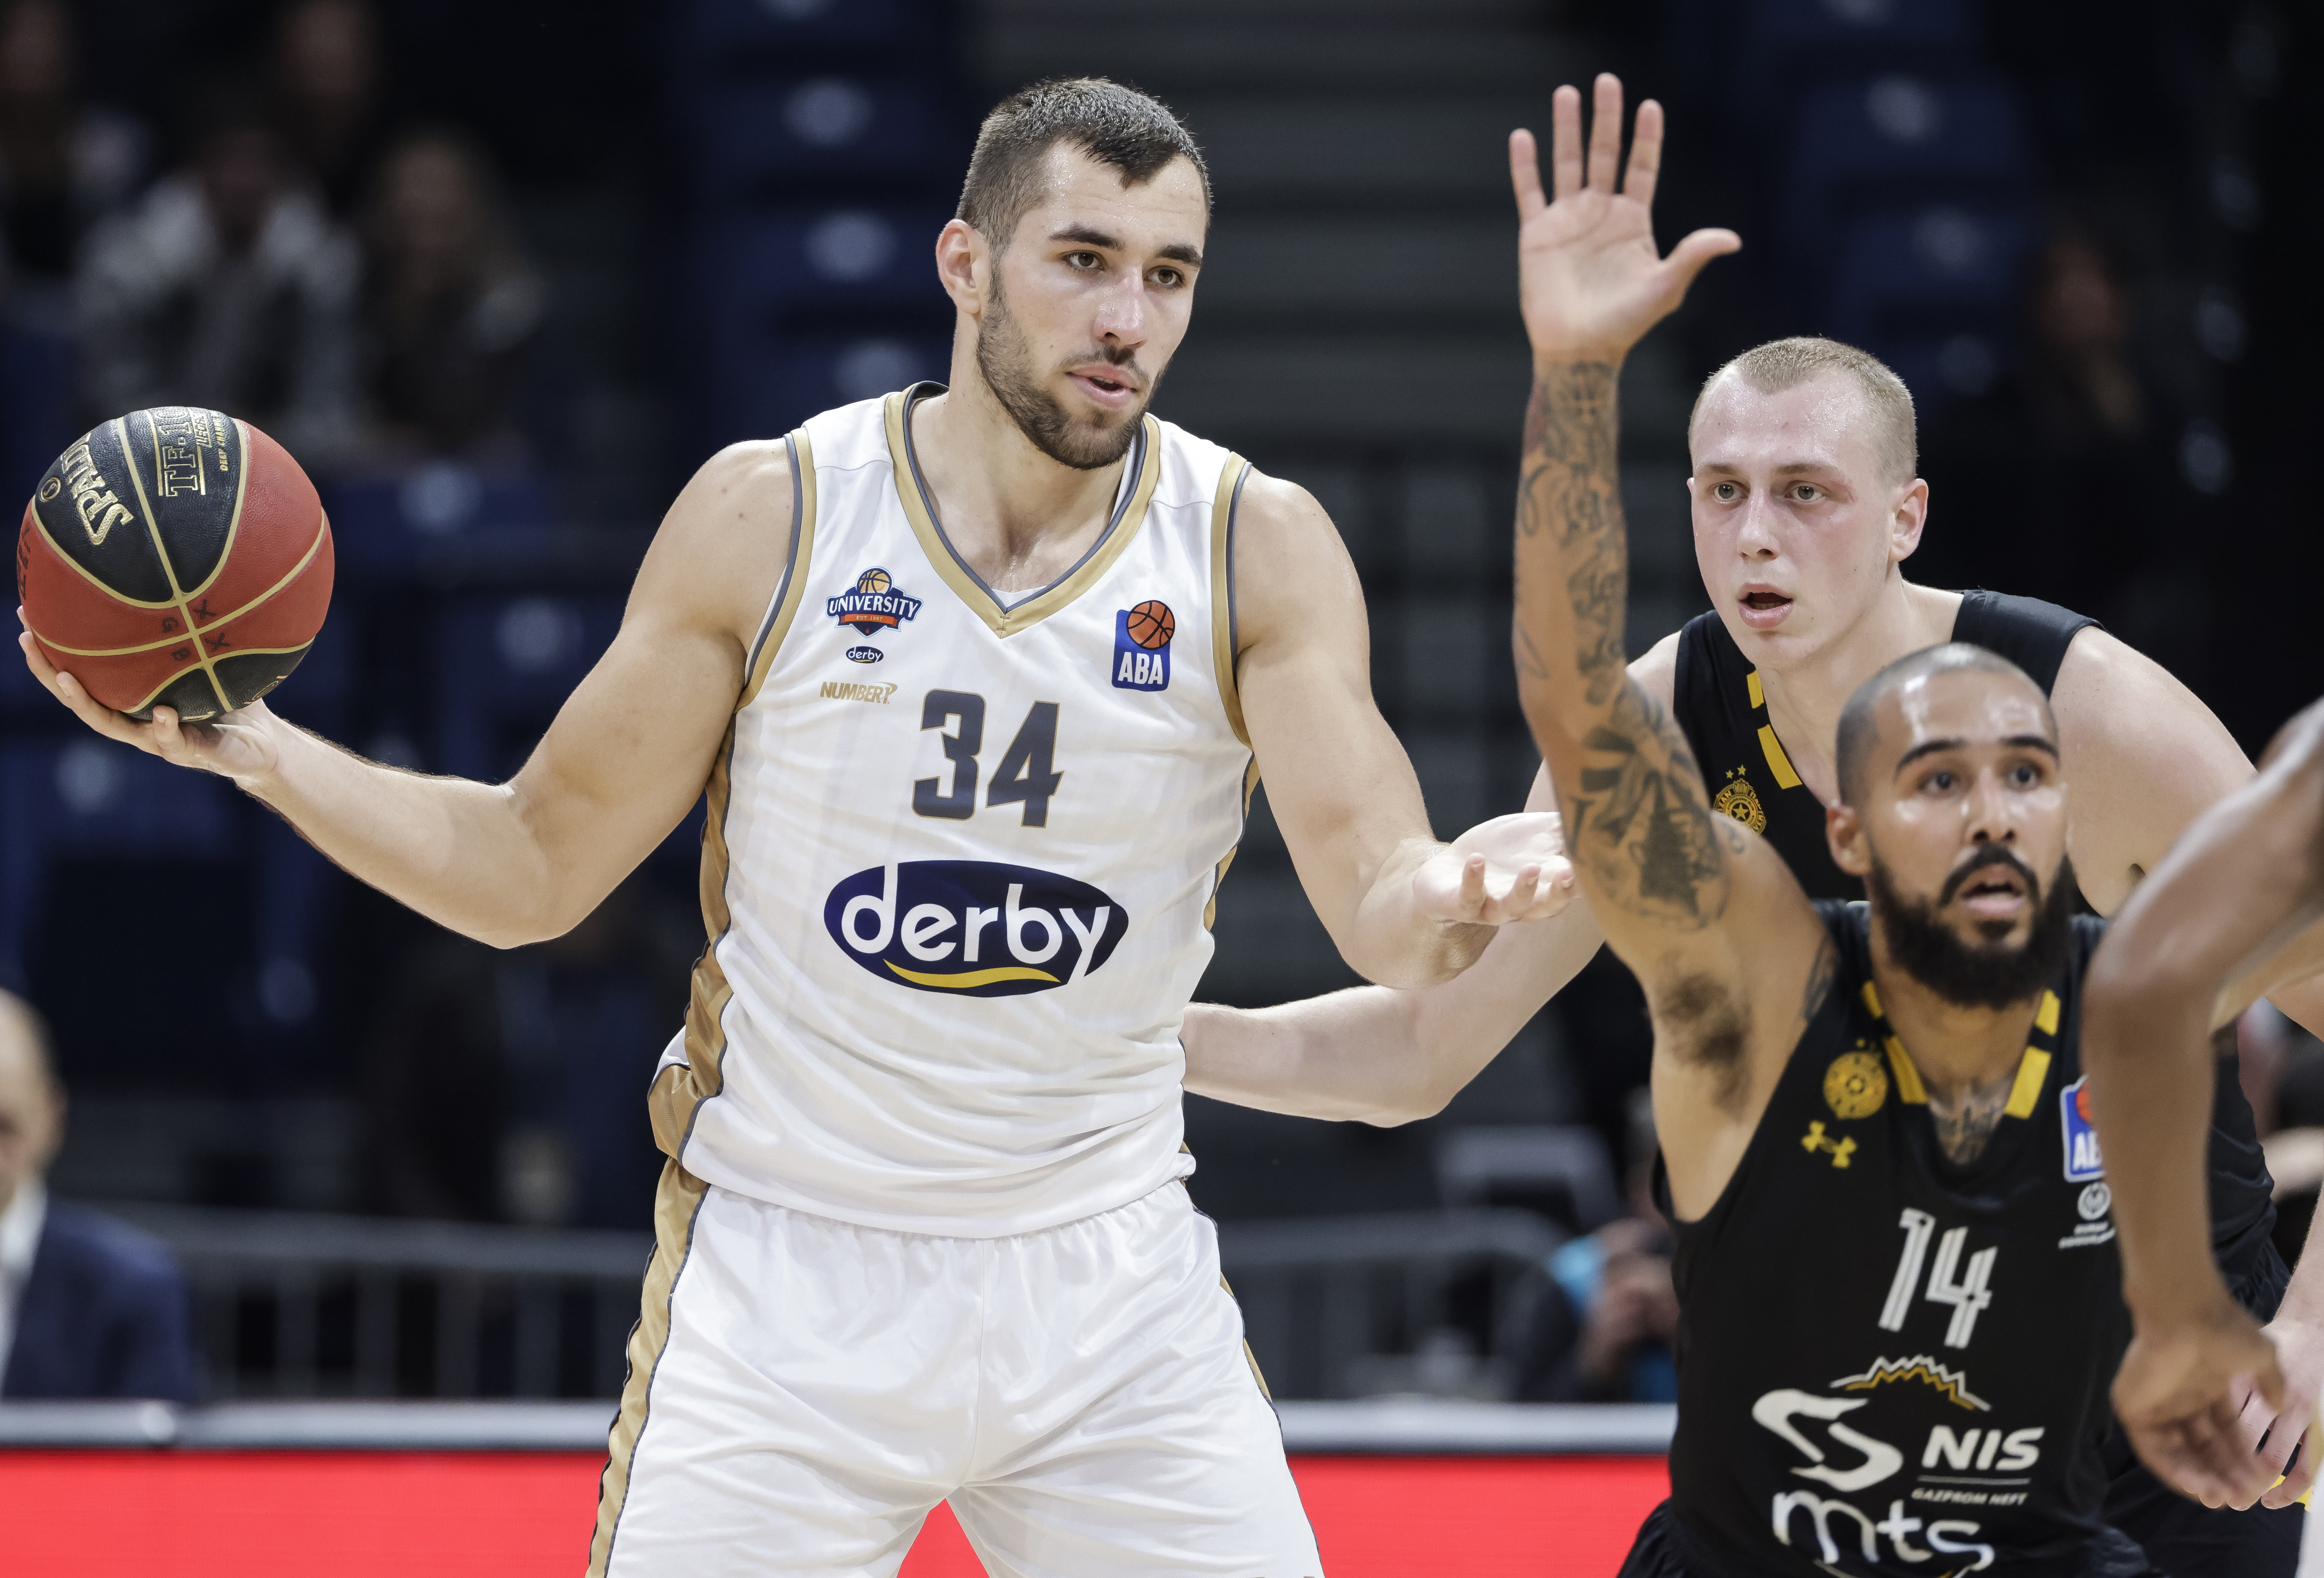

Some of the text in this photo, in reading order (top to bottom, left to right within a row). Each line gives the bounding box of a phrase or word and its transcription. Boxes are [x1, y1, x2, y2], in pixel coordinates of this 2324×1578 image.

[829, 595, 919, 618] UNIVERSITY
[848, 646, 882, 663] derby
[1117, 651, 1163, 685] ABA
[912, 688, 1064, 828] 34
[841, 863, 1110, 985] derby
[1878, 1207, 1998, 1349] 14
[1922, 1425, 2045, 1471] NIS
[1772, 1489, 1995, 1571] mts
